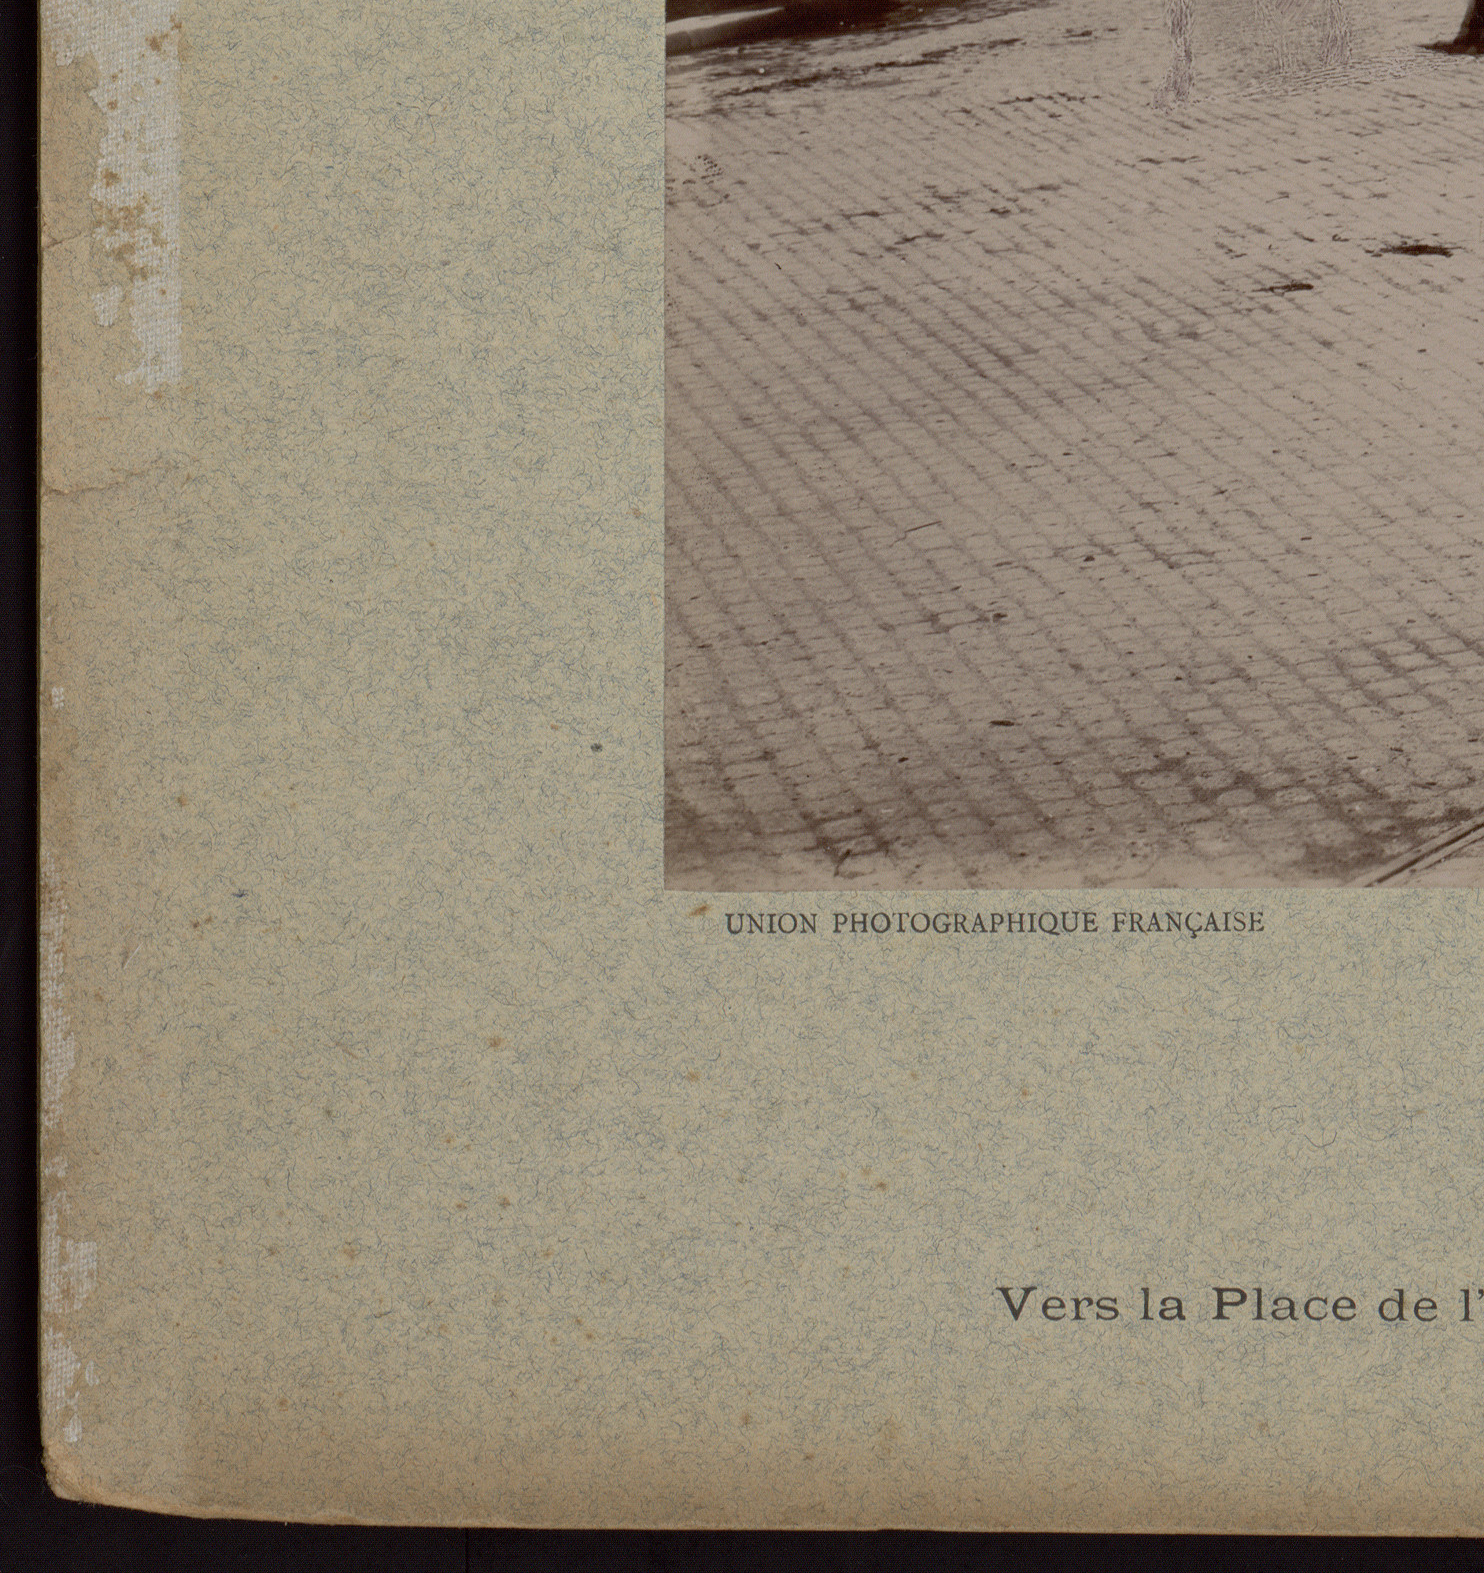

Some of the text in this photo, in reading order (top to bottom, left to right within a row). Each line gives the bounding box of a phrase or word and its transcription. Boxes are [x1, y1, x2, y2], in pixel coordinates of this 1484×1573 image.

[725, 910, 1266, 940] UNION PHOTOGRAPHIQUE FRANÇAISE
[996, 1286, 1120, 1323] Vers
[1140, 1286, 1186, 1323] la
[1212, 1286, 1357, 1323] Place
[1378, 1286, 1438, 1323] de
